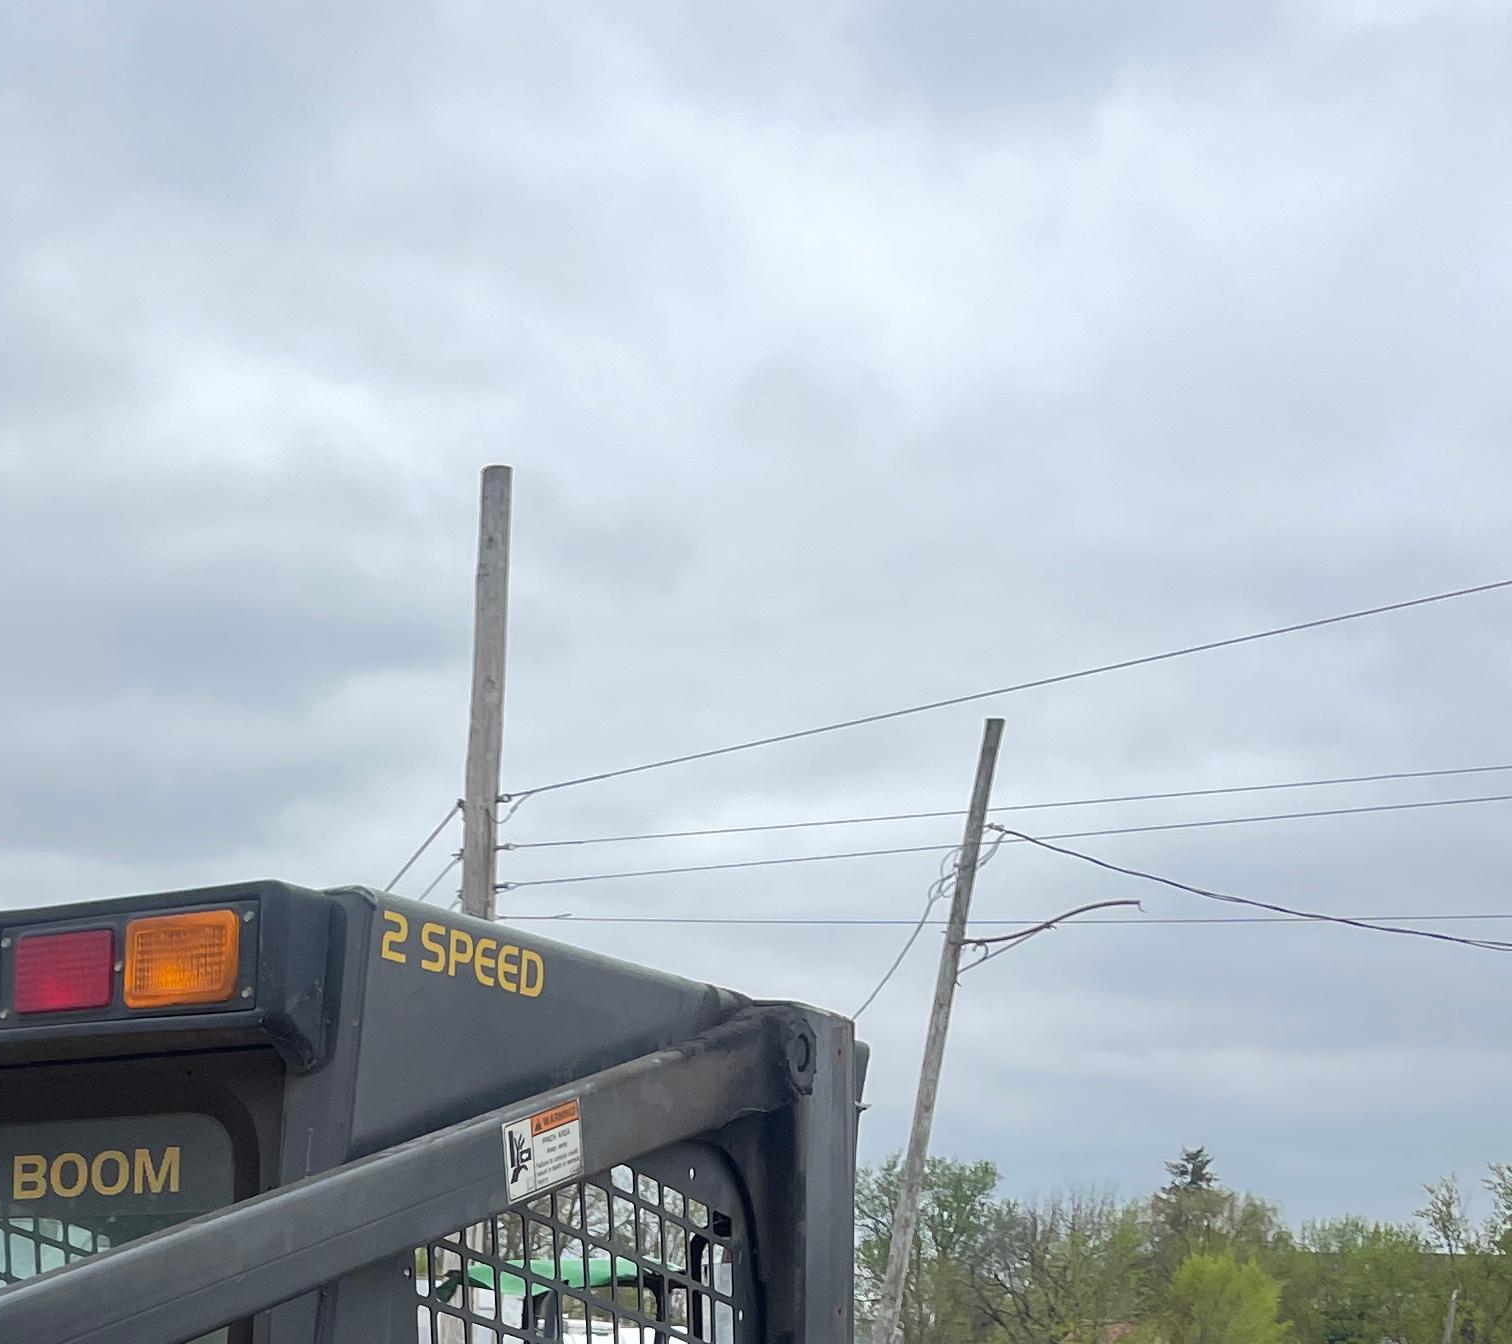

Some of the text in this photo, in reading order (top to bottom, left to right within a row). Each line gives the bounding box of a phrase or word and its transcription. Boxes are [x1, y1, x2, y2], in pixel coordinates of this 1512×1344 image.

[381, 910, 545, 998] 2 SPEED
[13, 1146, 181, 1201] BOOM
